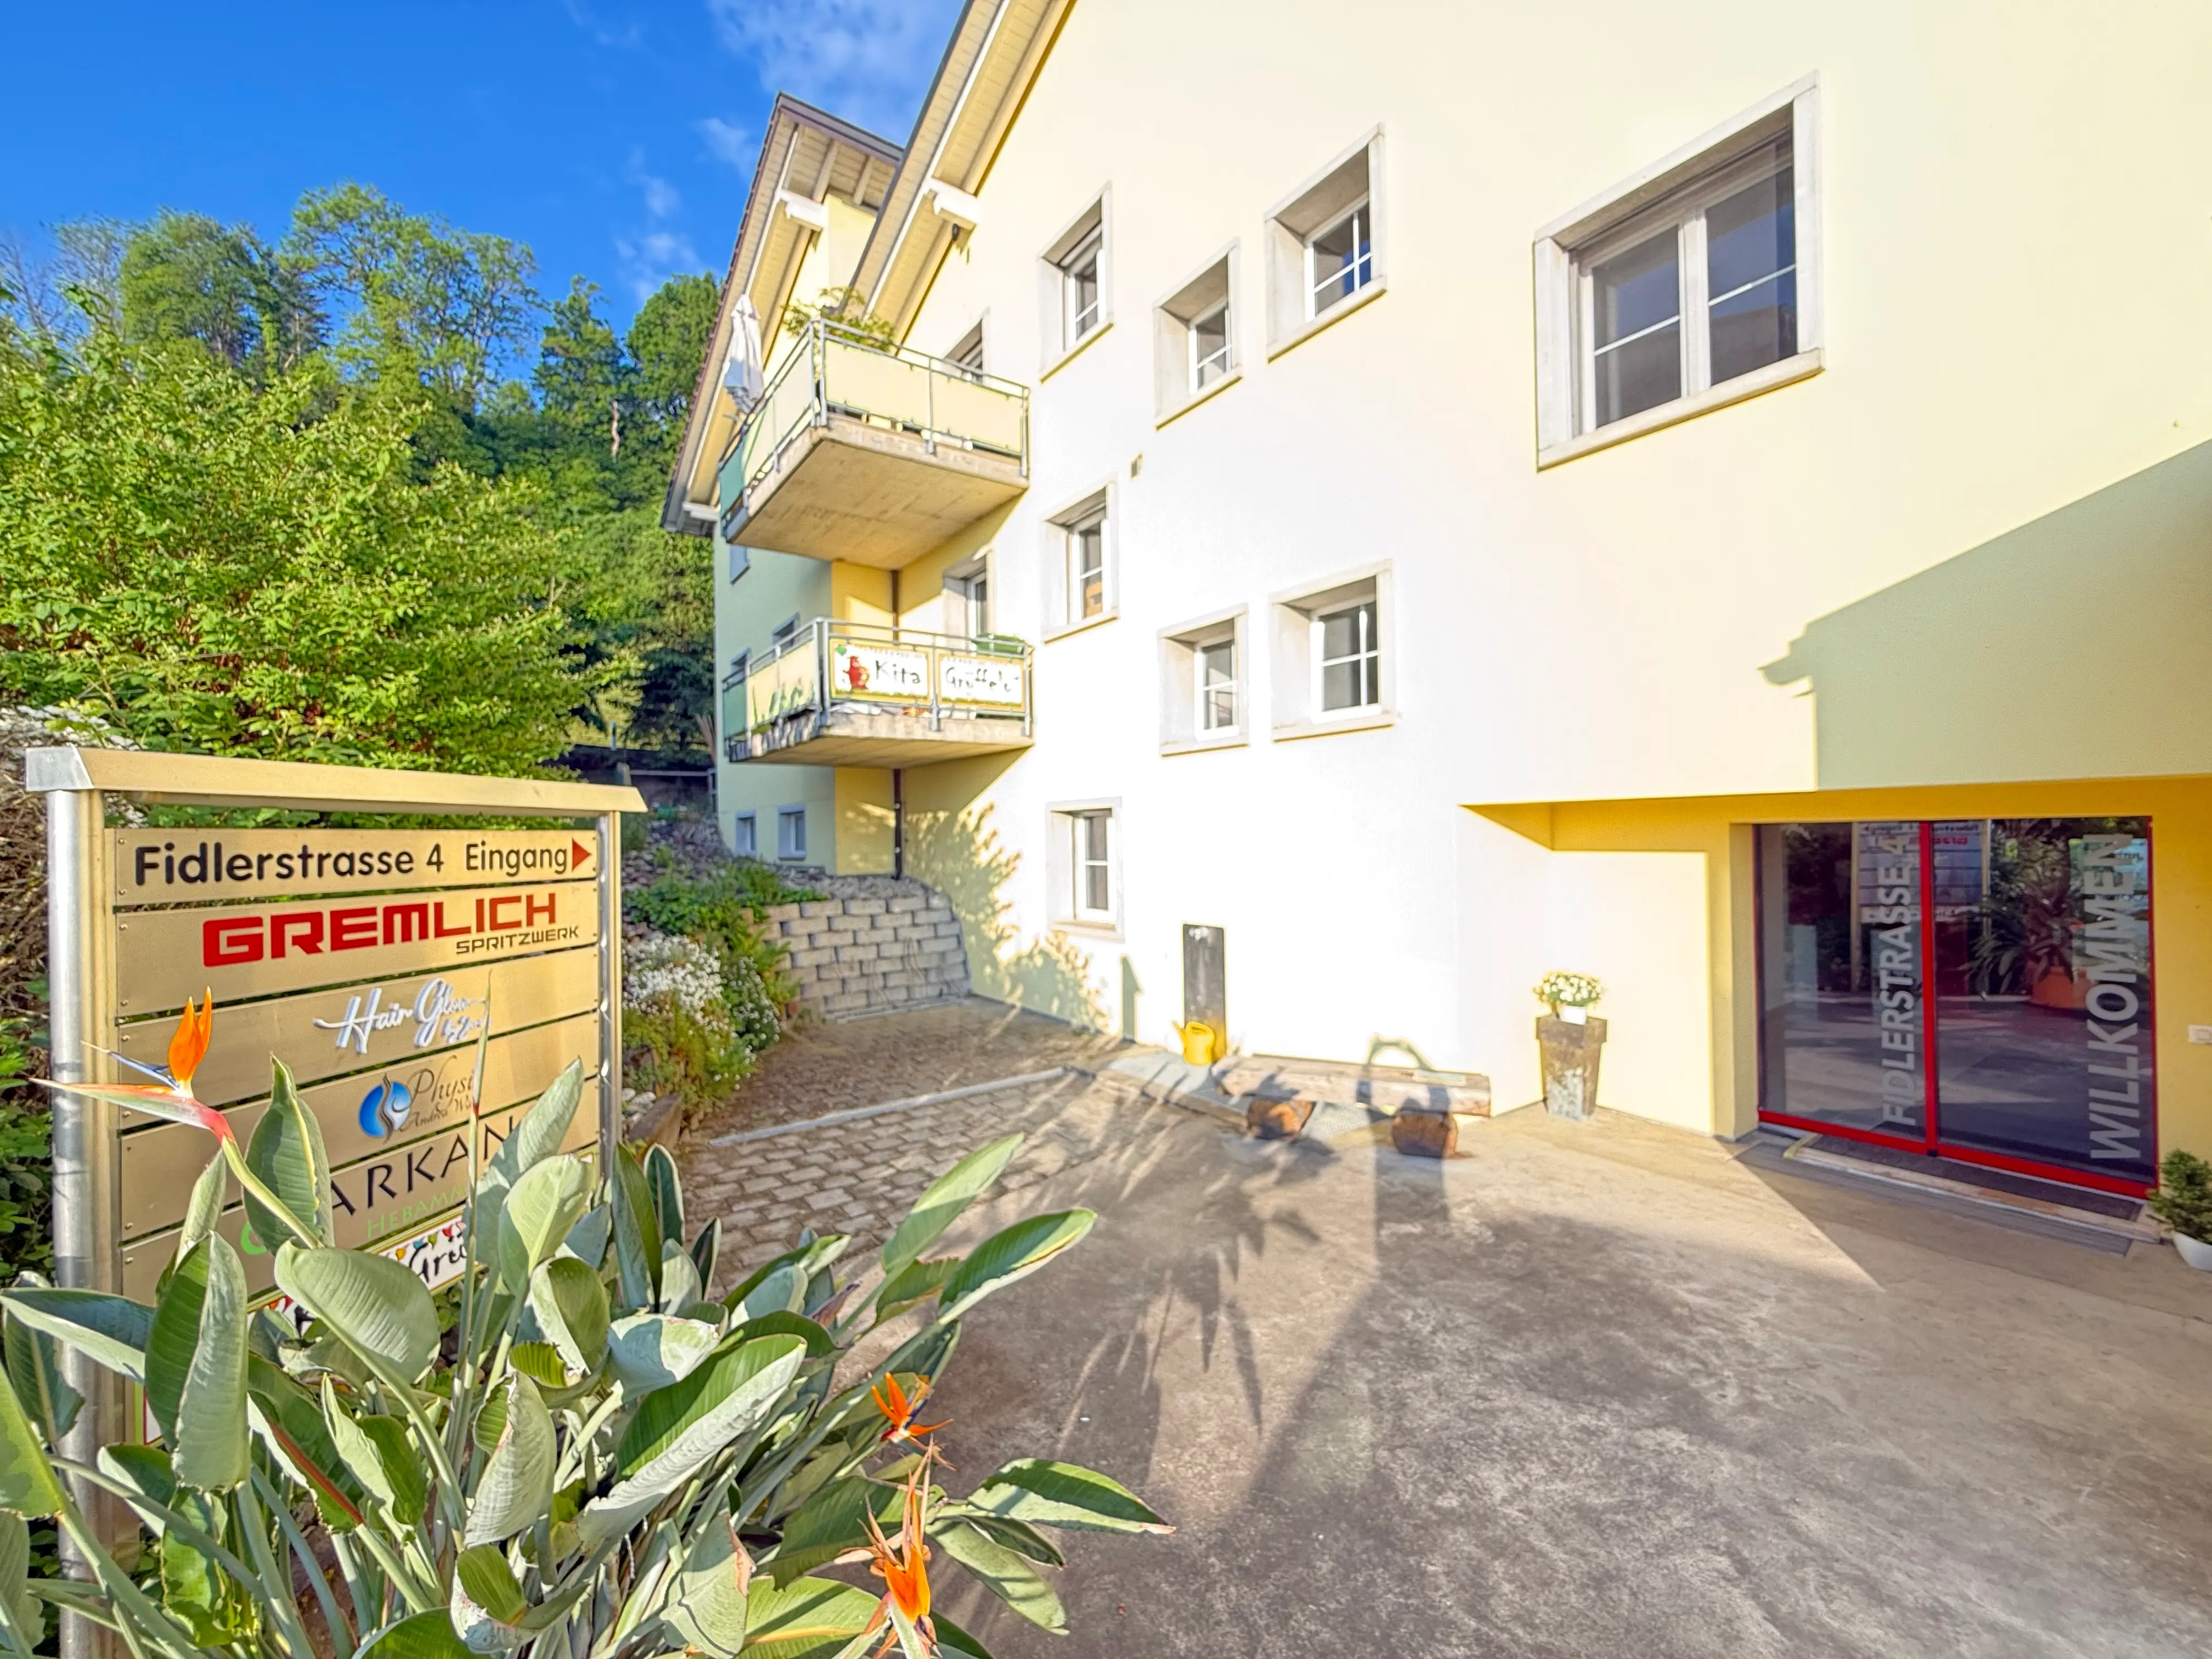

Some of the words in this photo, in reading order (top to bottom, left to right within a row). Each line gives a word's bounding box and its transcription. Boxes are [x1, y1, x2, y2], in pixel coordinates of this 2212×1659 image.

[876, 659, 921, 685] Kita
[136, 842, 414, 886] Fidlerstrasse
[426, 843, 444, 873] 4
[465, 840, 567, 877] Eingang
[202, 892, 557, 968] GREMLICH
[456, 924, 580, 955] SPRITZWERK
[313, 988, 413, 1054] Hair
[1876, 866, 1916, 1126] FIDLERSTRASSE
[2083, 834, 2141, 1159] WILLKOMMEN
